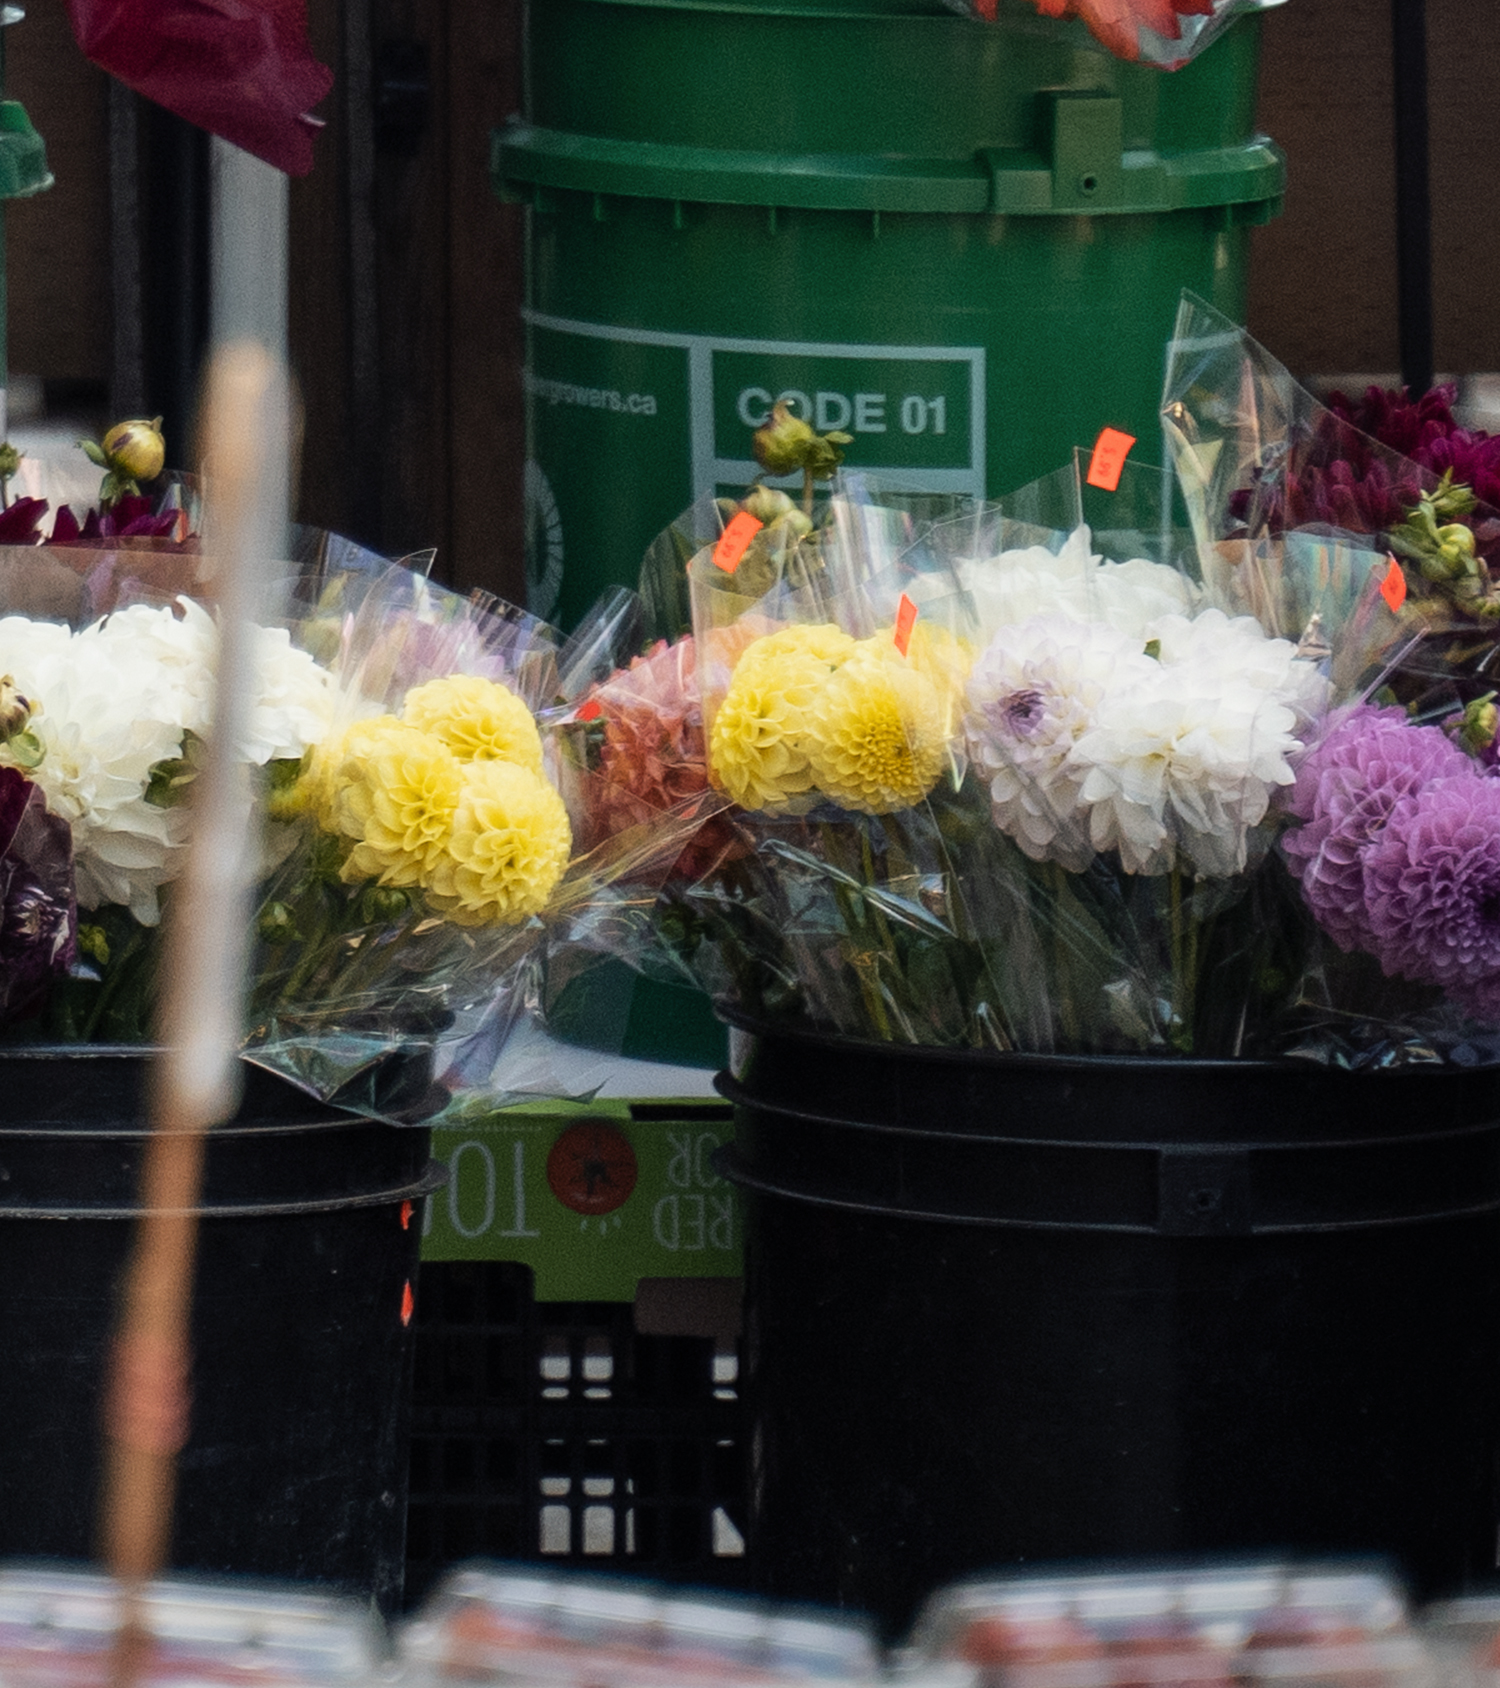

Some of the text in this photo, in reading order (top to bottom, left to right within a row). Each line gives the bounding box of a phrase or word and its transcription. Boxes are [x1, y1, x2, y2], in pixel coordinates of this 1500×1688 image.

[736, 387, 947, 435] CODE 01
[421, 1139, 541, 1239] TO
[653, 1193, 735, 1252] RED
